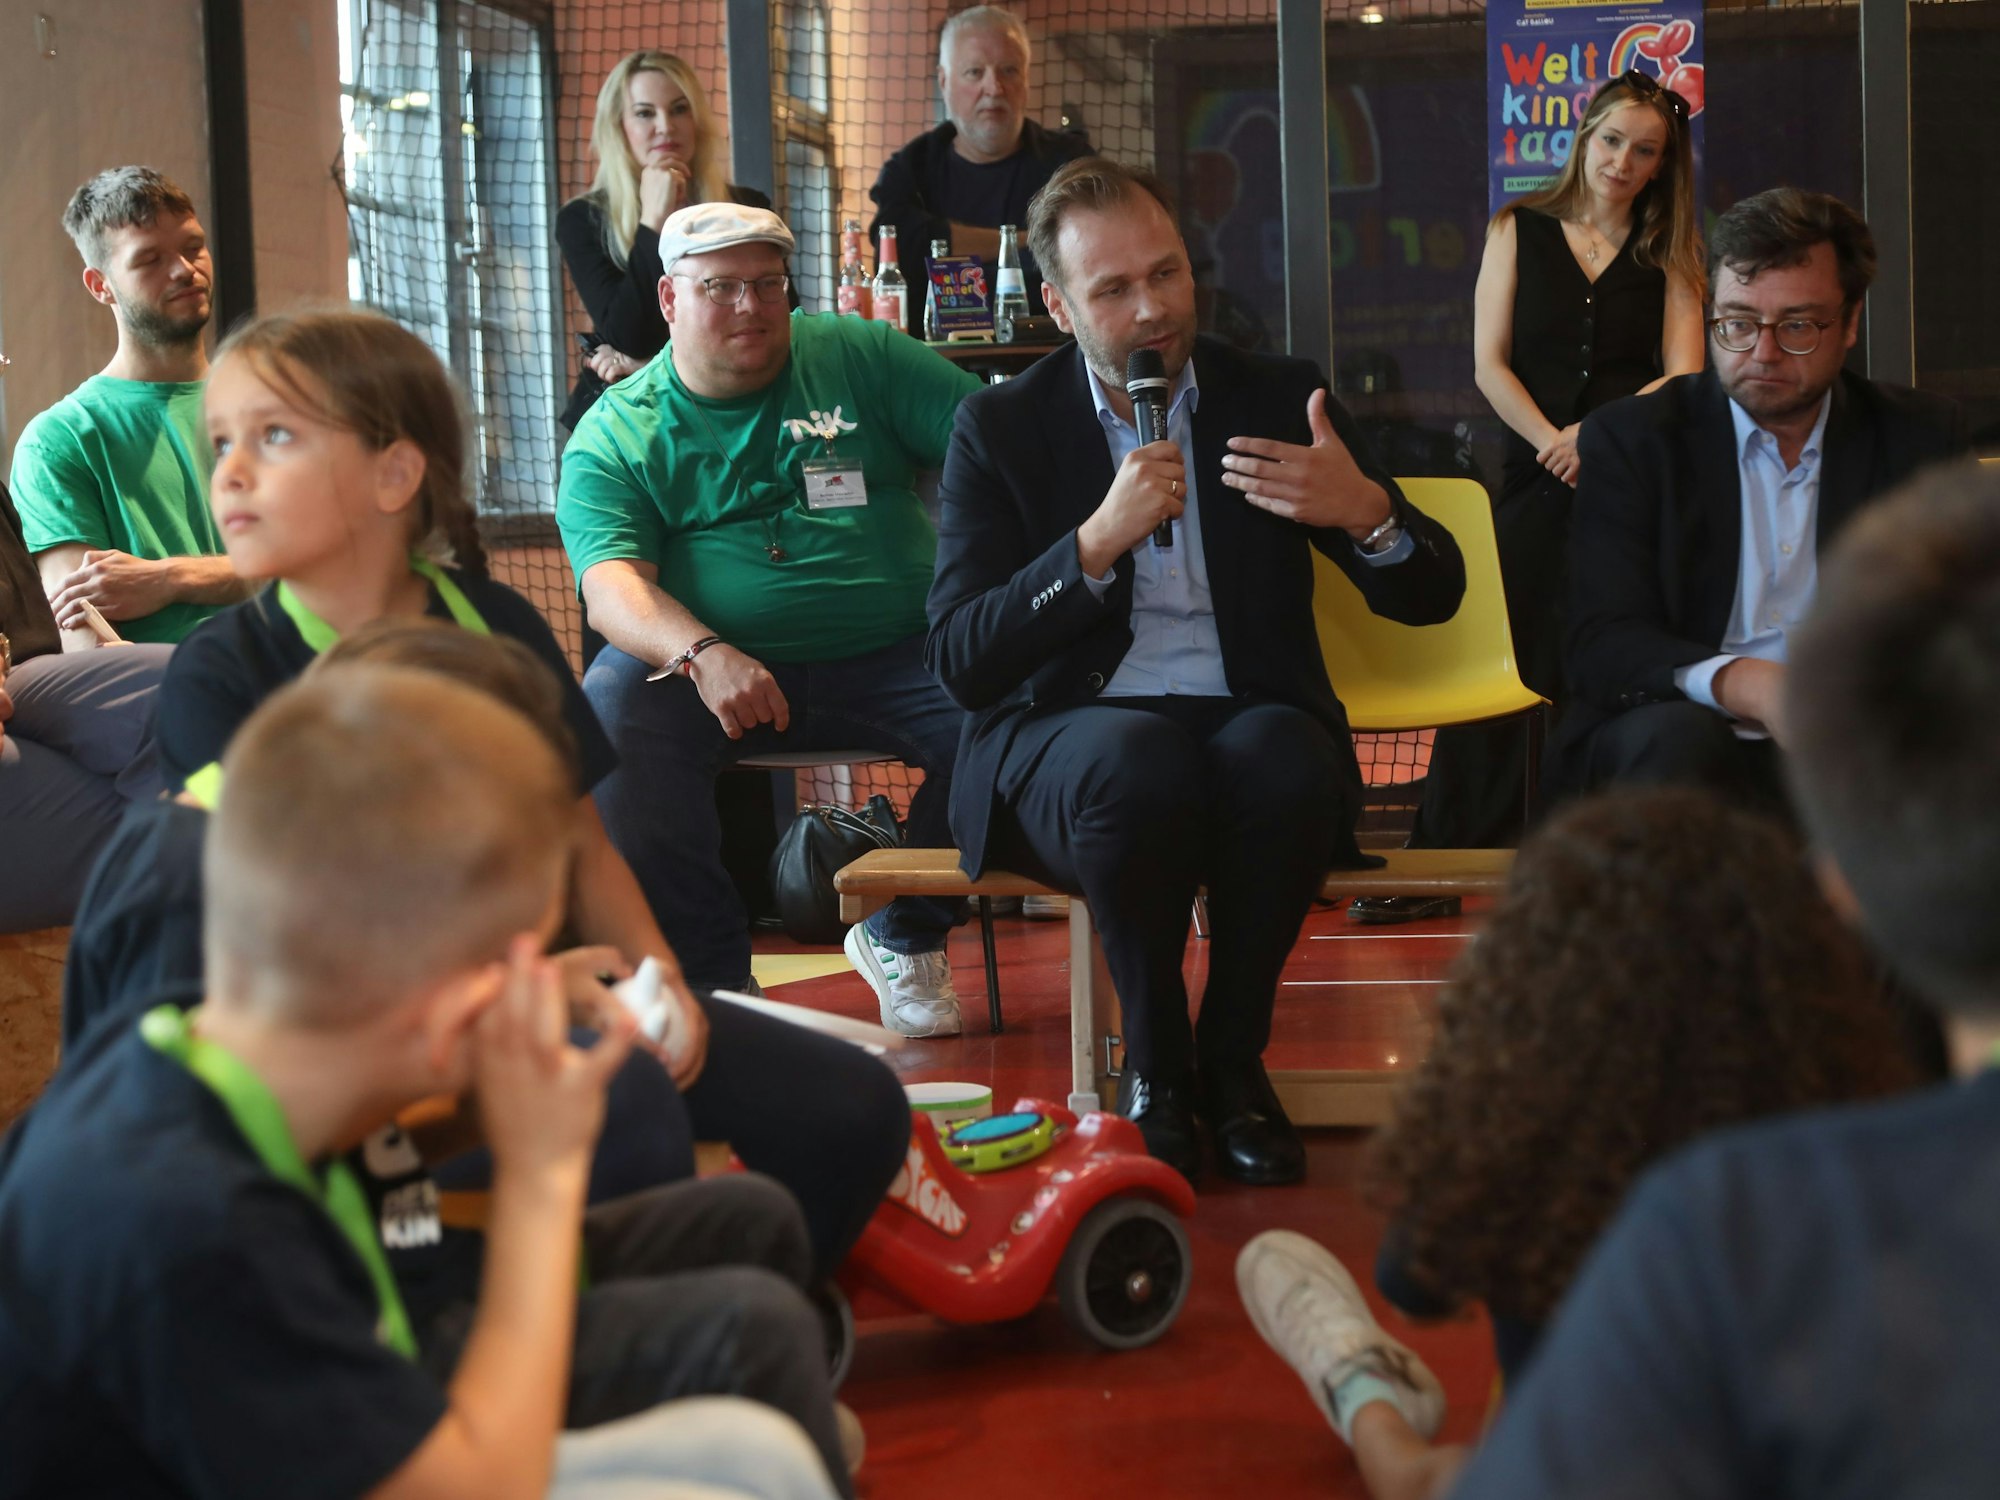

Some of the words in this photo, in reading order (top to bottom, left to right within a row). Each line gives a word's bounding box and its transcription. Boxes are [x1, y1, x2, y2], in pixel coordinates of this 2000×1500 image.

[1502, 41, 1598, 86] Welt
[1503, 128, 1574, 168] tag
[934, 283, 973, 296] kinder
